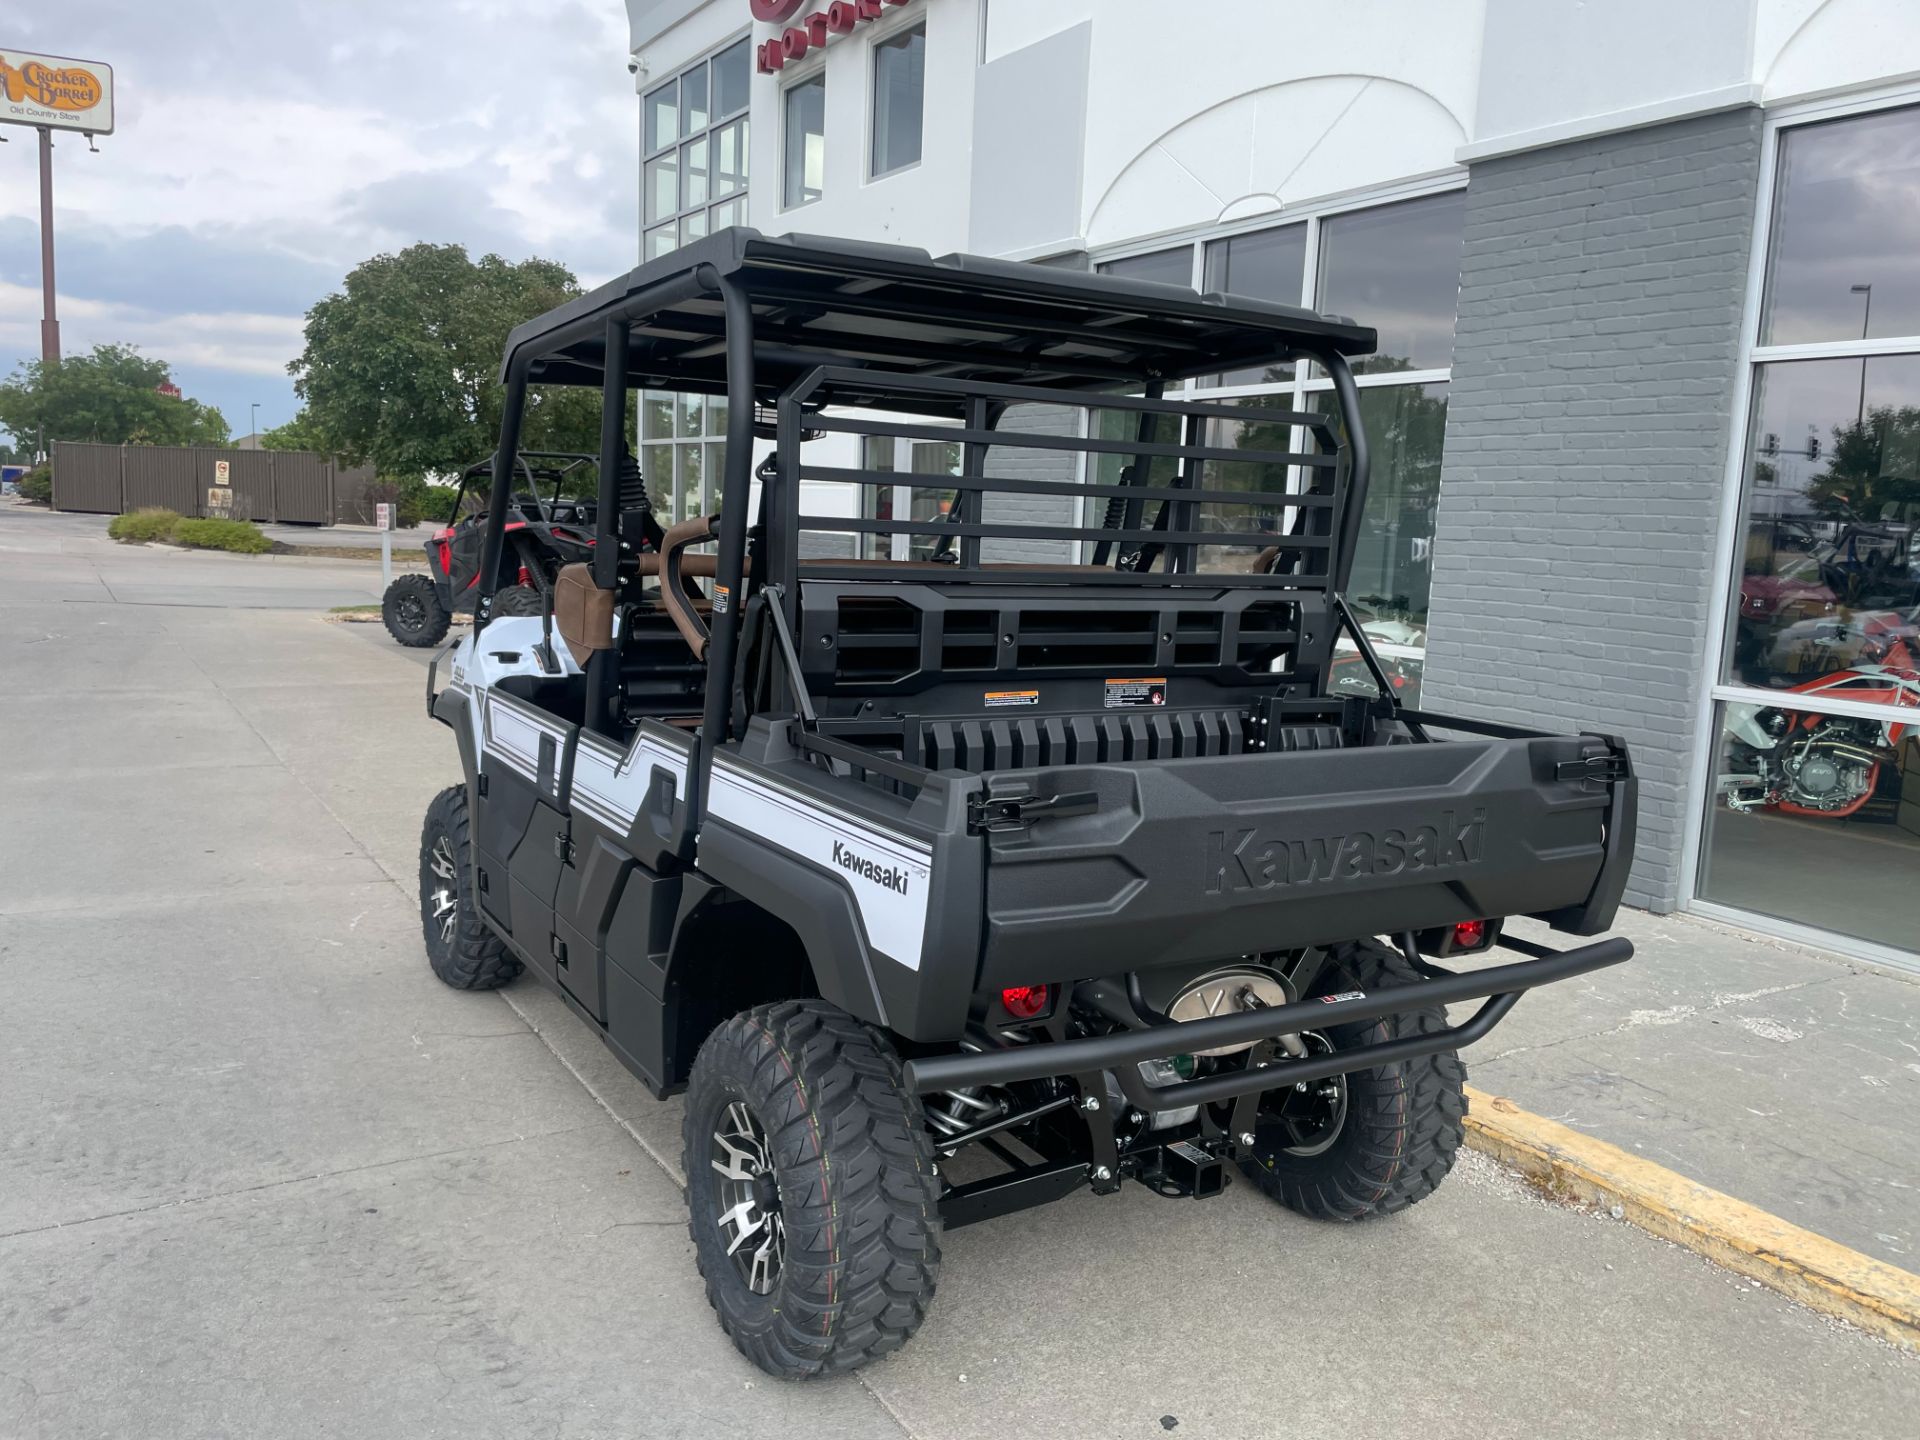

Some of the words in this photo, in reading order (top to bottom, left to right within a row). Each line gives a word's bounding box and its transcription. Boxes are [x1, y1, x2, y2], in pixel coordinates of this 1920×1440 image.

[757, 0, 911, 75] MOTOR
[10, 106, 24, 115] Old
[26, 107, 57, 119] Country
[59, 111, 80, 121] Store
[832, 839, 908, 896] Kawasaki
[1205, 807, 1486, 895] Kawasaki
